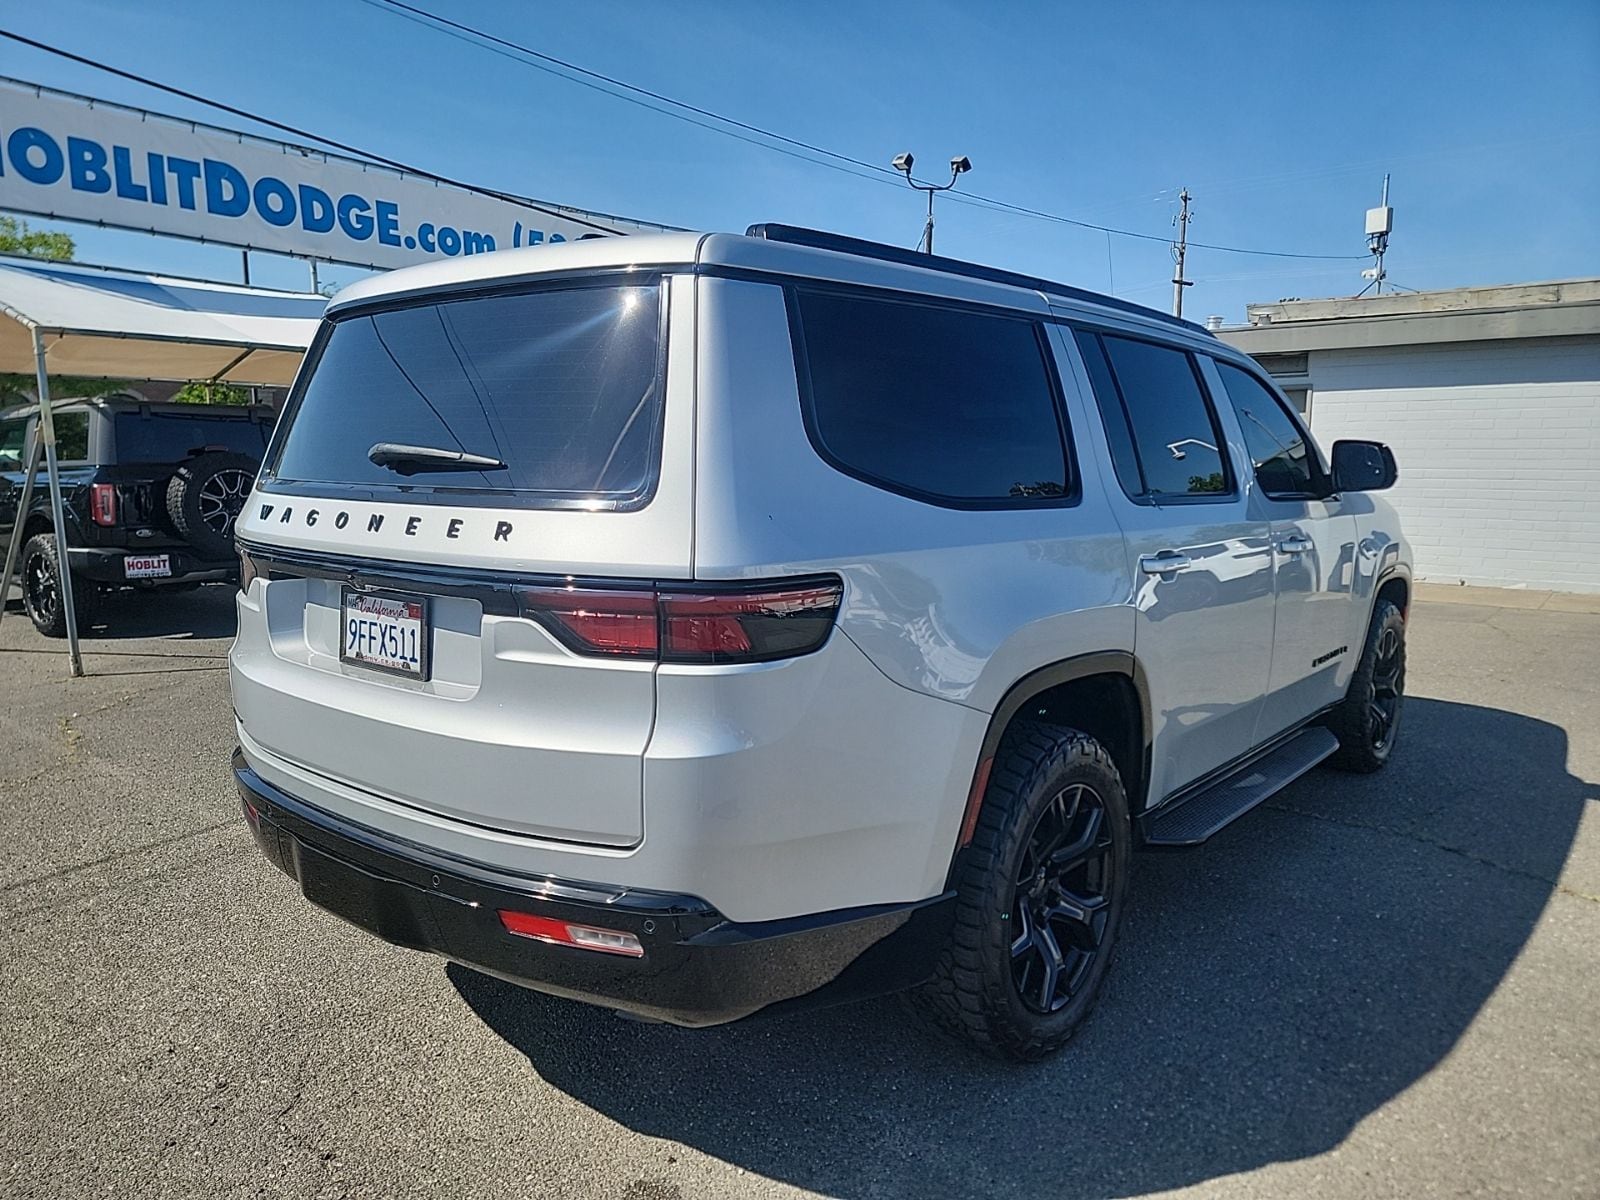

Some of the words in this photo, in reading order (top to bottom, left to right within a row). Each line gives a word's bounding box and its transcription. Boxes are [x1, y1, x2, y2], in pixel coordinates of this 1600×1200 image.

[0, 127, 496, 256] OBLITDODGE.com
[259, 504, 514, 542] WAGONEER
[127, 559, 168, 571] HOBLIT
[359, 597, 404, 620] California
[348, 619, 418, 663] 9FFX511
